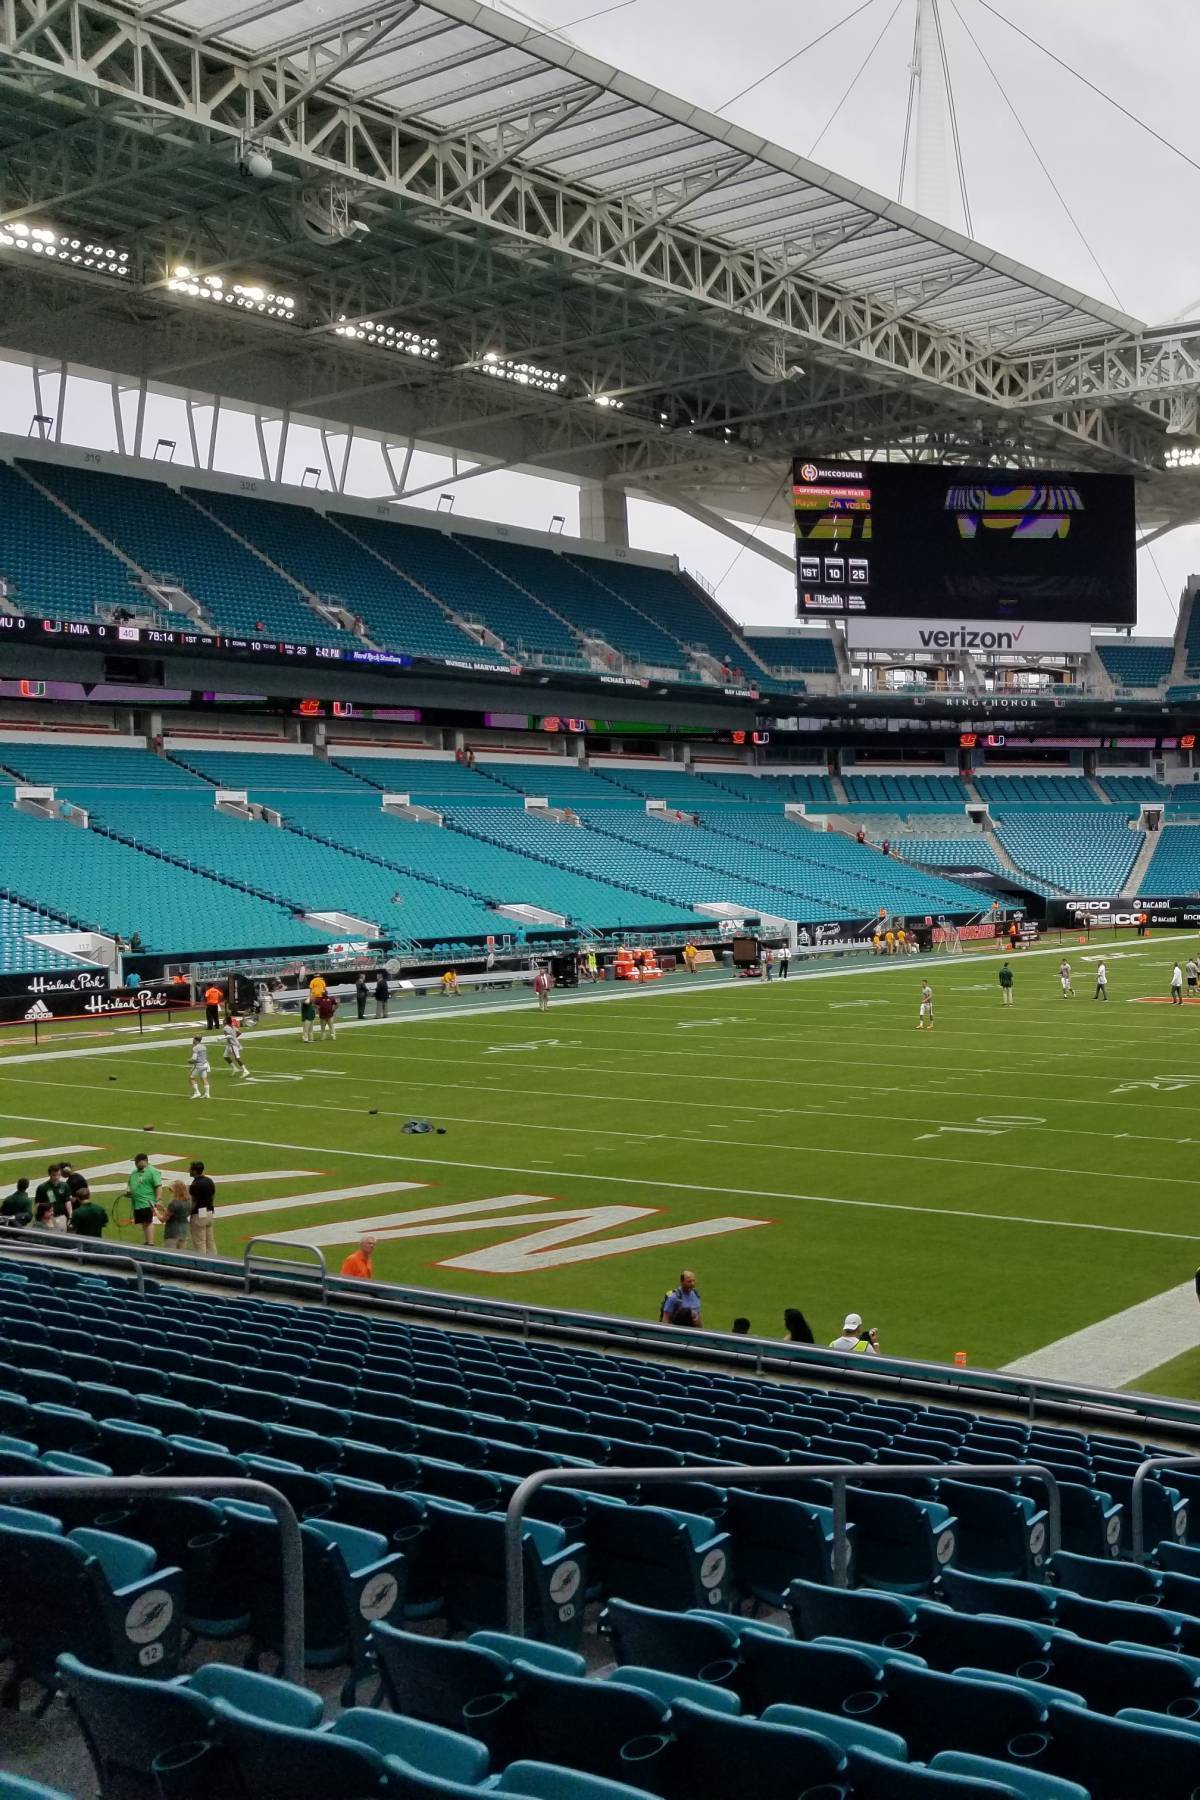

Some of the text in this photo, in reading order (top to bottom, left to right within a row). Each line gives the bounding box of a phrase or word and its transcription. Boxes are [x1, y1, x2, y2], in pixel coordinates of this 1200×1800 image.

[802, 568, 818, 577] 1ST
[829, 569, 841, 579] 10
[852, 570, 866, 580] 25
[18, 618, 26, 629] 0
[69, 623, 106, 636] MIA 0
[122, 630, 135, 638] 40
[148, 631, 174, 643] 78:14
[185, 636, 197, 644] 1ST
[918, 625, 1013, 649] verizon
[251, 641, 261, 651] 10
[296, 646, 307, 655] 25
[315, 647, 340, 658] 2:42 PM
[600, 676, 625, 685] MICHAEL
[946, 698, 979, 707] RING
[991, 698, 1038, 707] HONOR
[1065, 901, 1111, 910] GEICO
[27, 973, 105, 993] Hialeah Park
[24, 1011, 54, 1020] adidas
[912, 1114, 1048, 1141] 10
[561, 1606, 574, 1618] 10
[143, 1646, 160, 1661] 12
